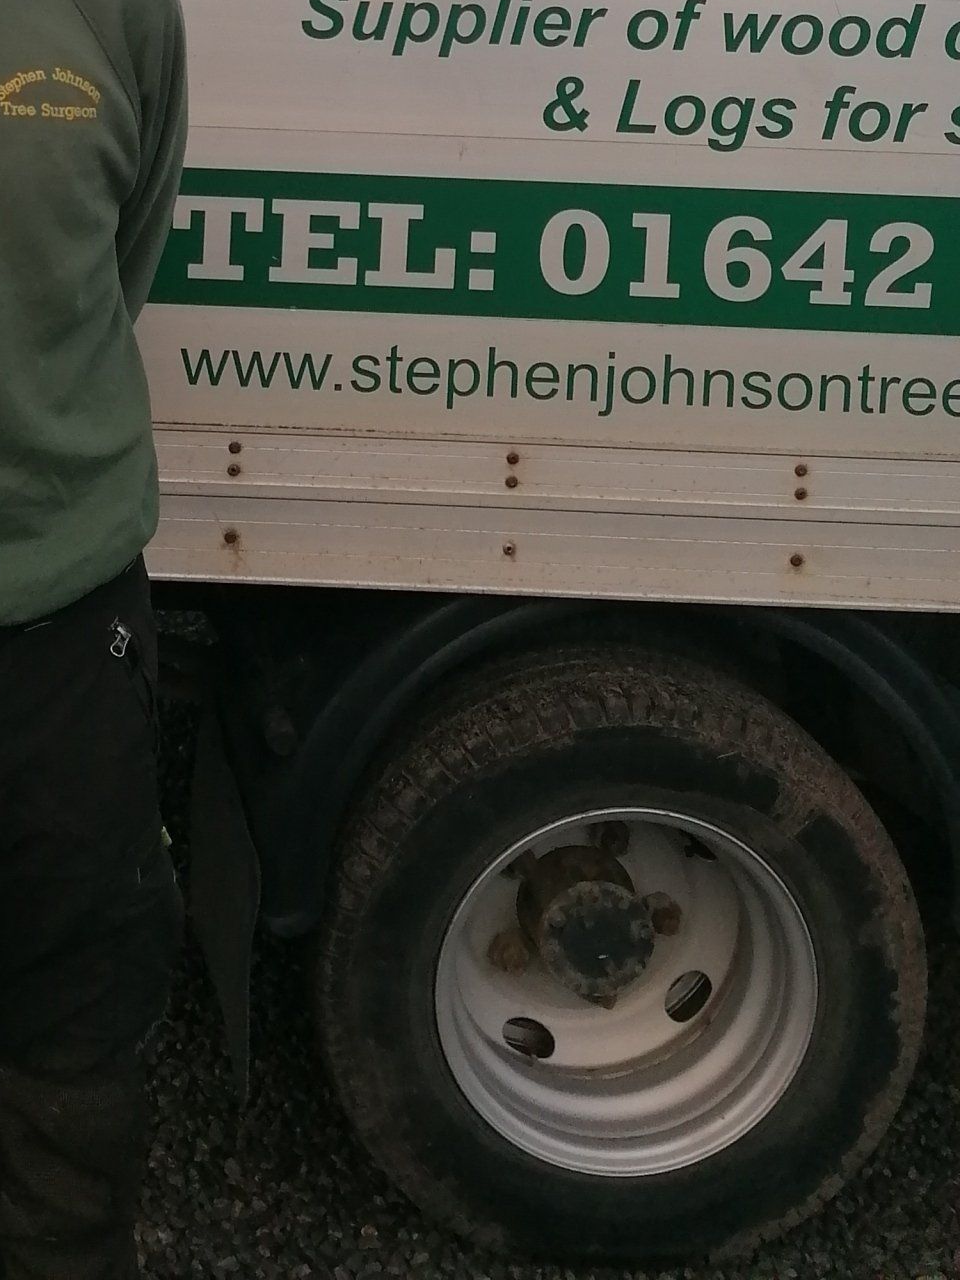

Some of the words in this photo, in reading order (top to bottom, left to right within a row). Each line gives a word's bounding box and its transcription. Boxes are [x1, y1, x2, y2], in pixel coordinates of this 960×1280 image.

[723, 4, 926, 58] wood
[0, 102, 37, 116] Tree
[41, 103, 97, 120] Surgeon
[52, 67, 100, 104] Johnson
[542, 76, 590, 132] &
[616, 79, 797, 152] Logs
[821, 85, 929, 143] for
[171, 195, 497, 292] TEL:
[539, 208, 935, 308] 01642
